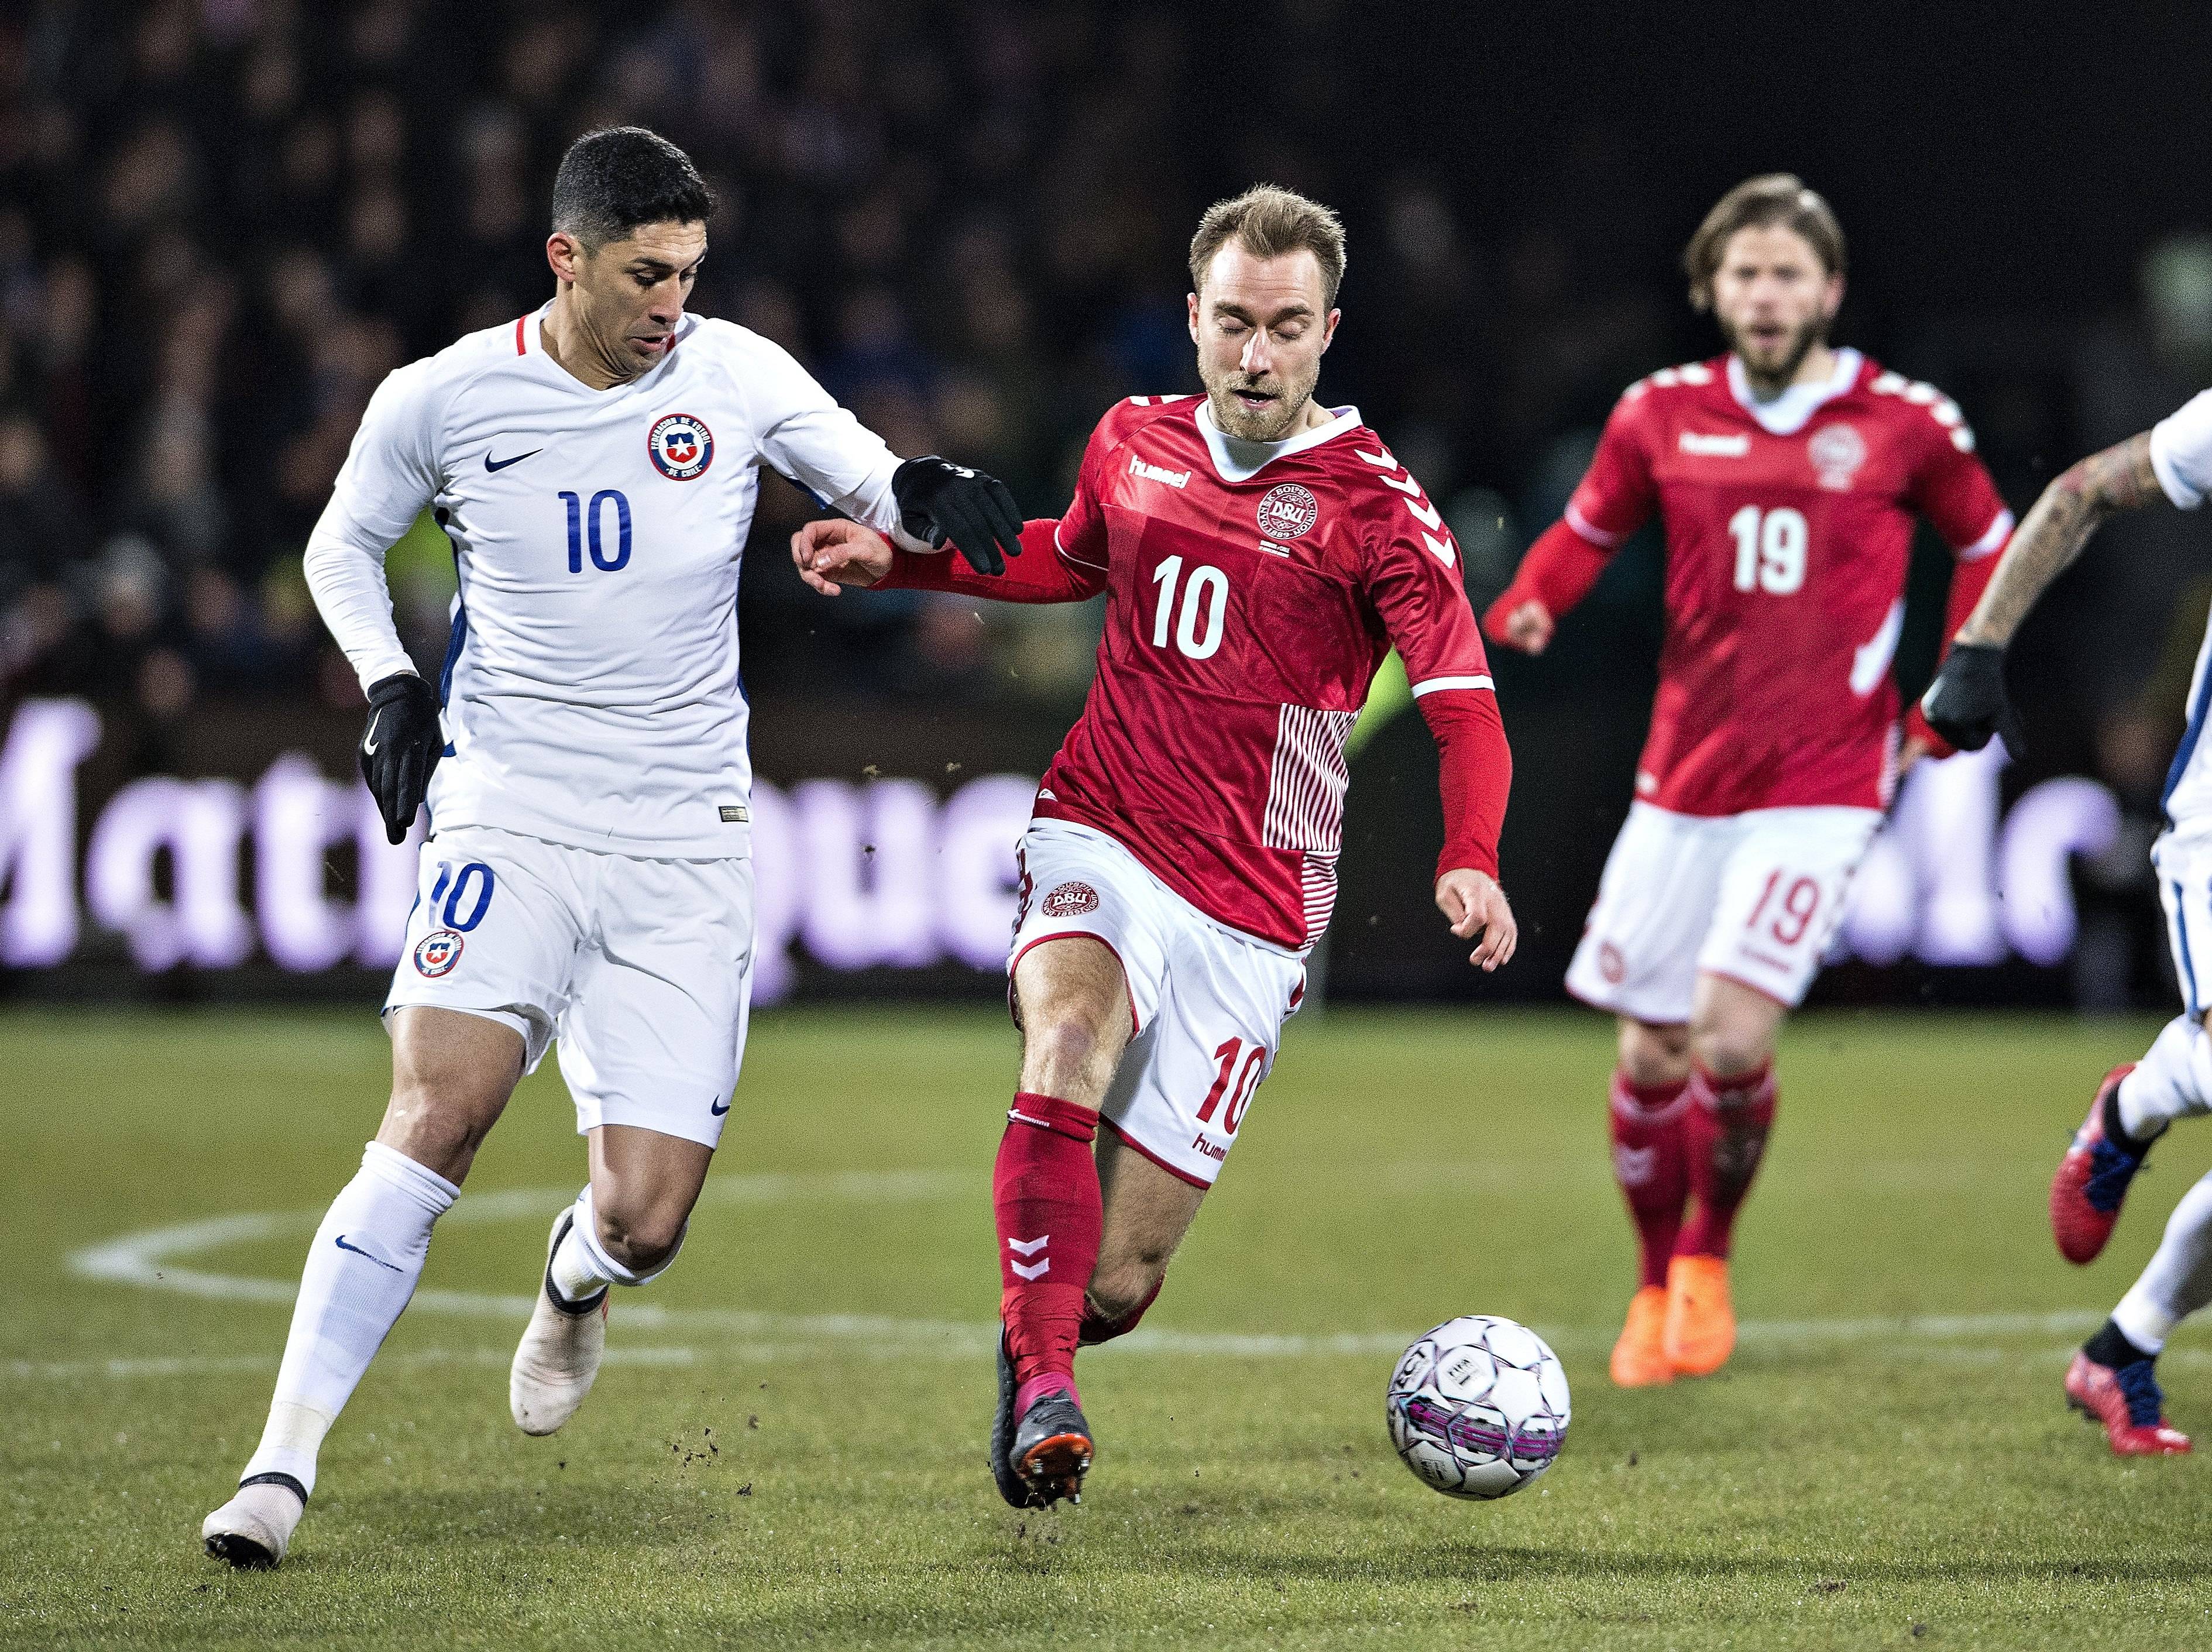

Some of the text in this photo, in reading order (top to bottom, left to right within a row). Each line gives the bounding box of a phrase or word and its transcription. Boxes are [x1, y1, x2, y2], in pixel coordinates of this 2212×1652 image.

[1128, 454, 1192, 489] hummel
[558, 489, 632, 573] 10
[1259, 494, 1276, 527] DANSK
[1293, 509, 1316, 535] UNION
[1269, 500, 1307, 524] DBU
[1729, 504, 1809, 595] 19
[1152, 555, 1229, 660] 10
[428, 861, 494, 933] 10
[1052, 892, 1088, 907] DBU
[1746, 867, 1822, 947] 19
[1196, 1035, 1267, 1135] 10
